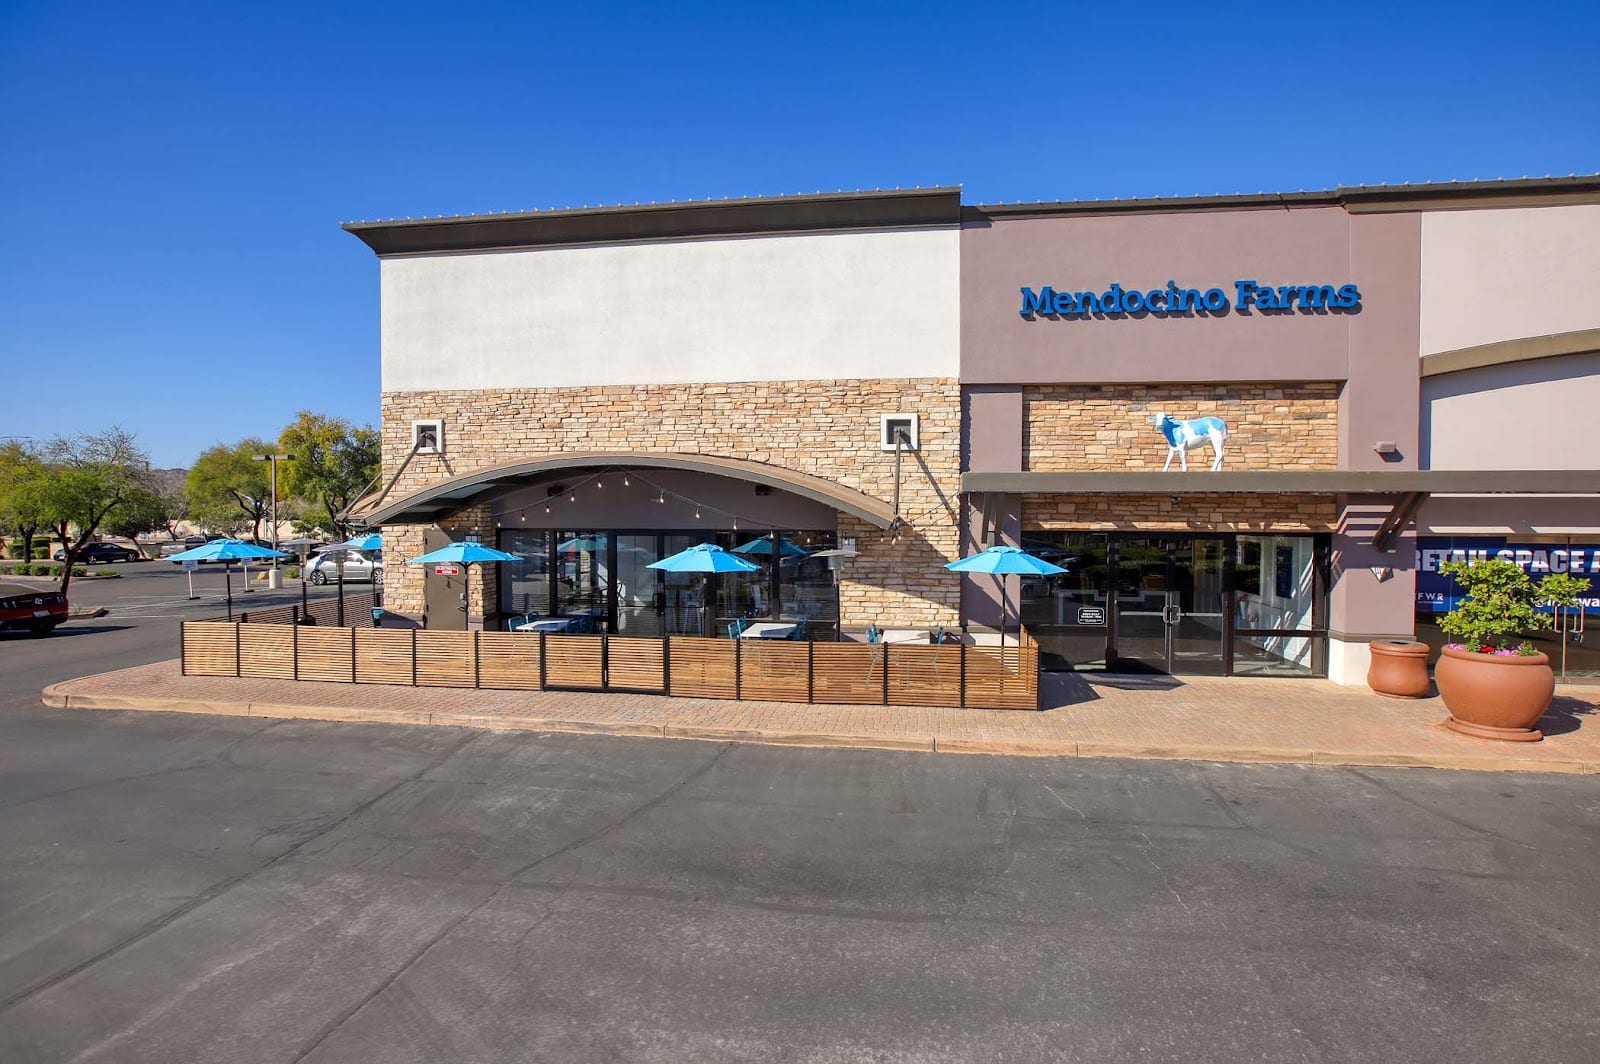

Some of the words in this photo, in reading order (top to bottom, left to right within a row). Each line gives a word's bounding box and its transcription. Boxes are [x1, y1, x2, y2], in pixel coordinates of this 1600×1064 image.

[1020, 280, 1226, 316] Mendocino
[1234, 280, 1360, 311] Farms
[1497, 549, 1584, 573] SPACE
